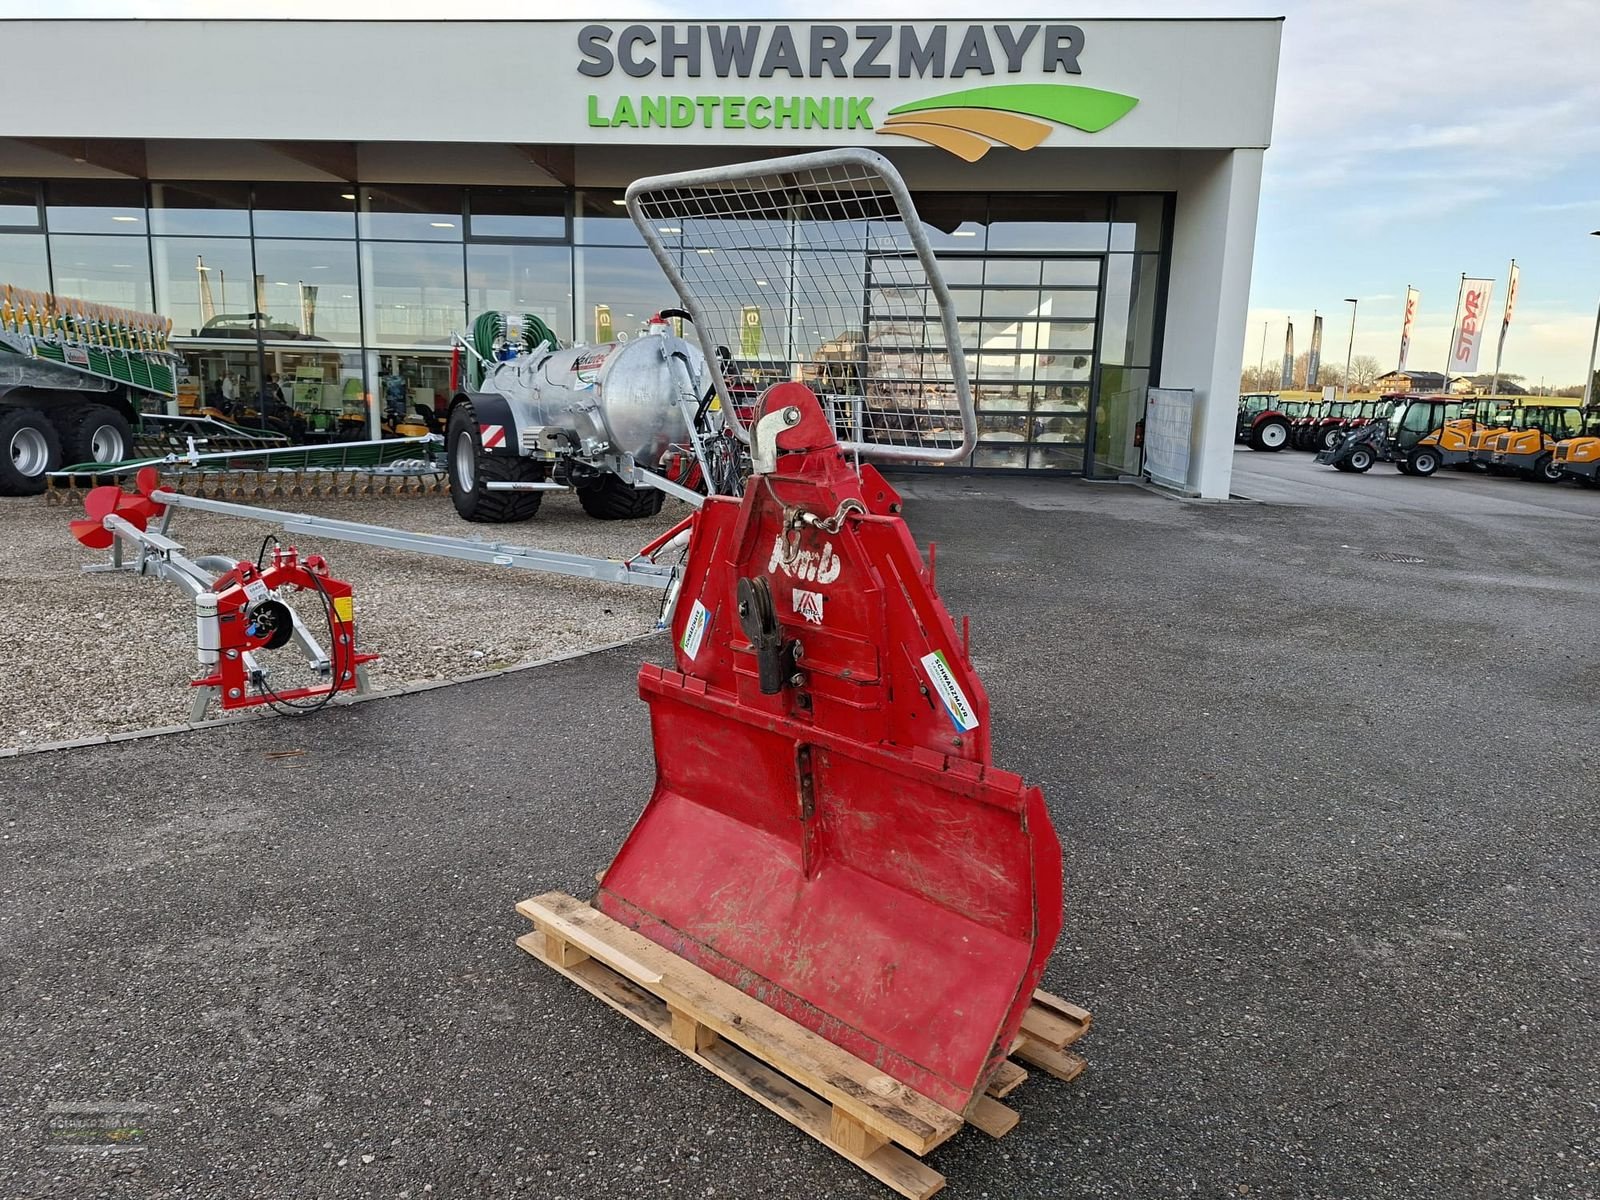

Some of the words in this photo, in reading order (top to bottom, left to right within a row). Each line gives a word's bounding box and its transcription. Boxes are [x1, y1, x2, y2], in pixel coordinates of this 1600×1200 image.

[577, 24, 1084, 78] SCHWARZMAYR
[588, 94, 874, 129] LANDTECHNIK
[1456, 290, 1481, 363] STEYR
[935, 658, 968, 717] SCHWARZMAYR
